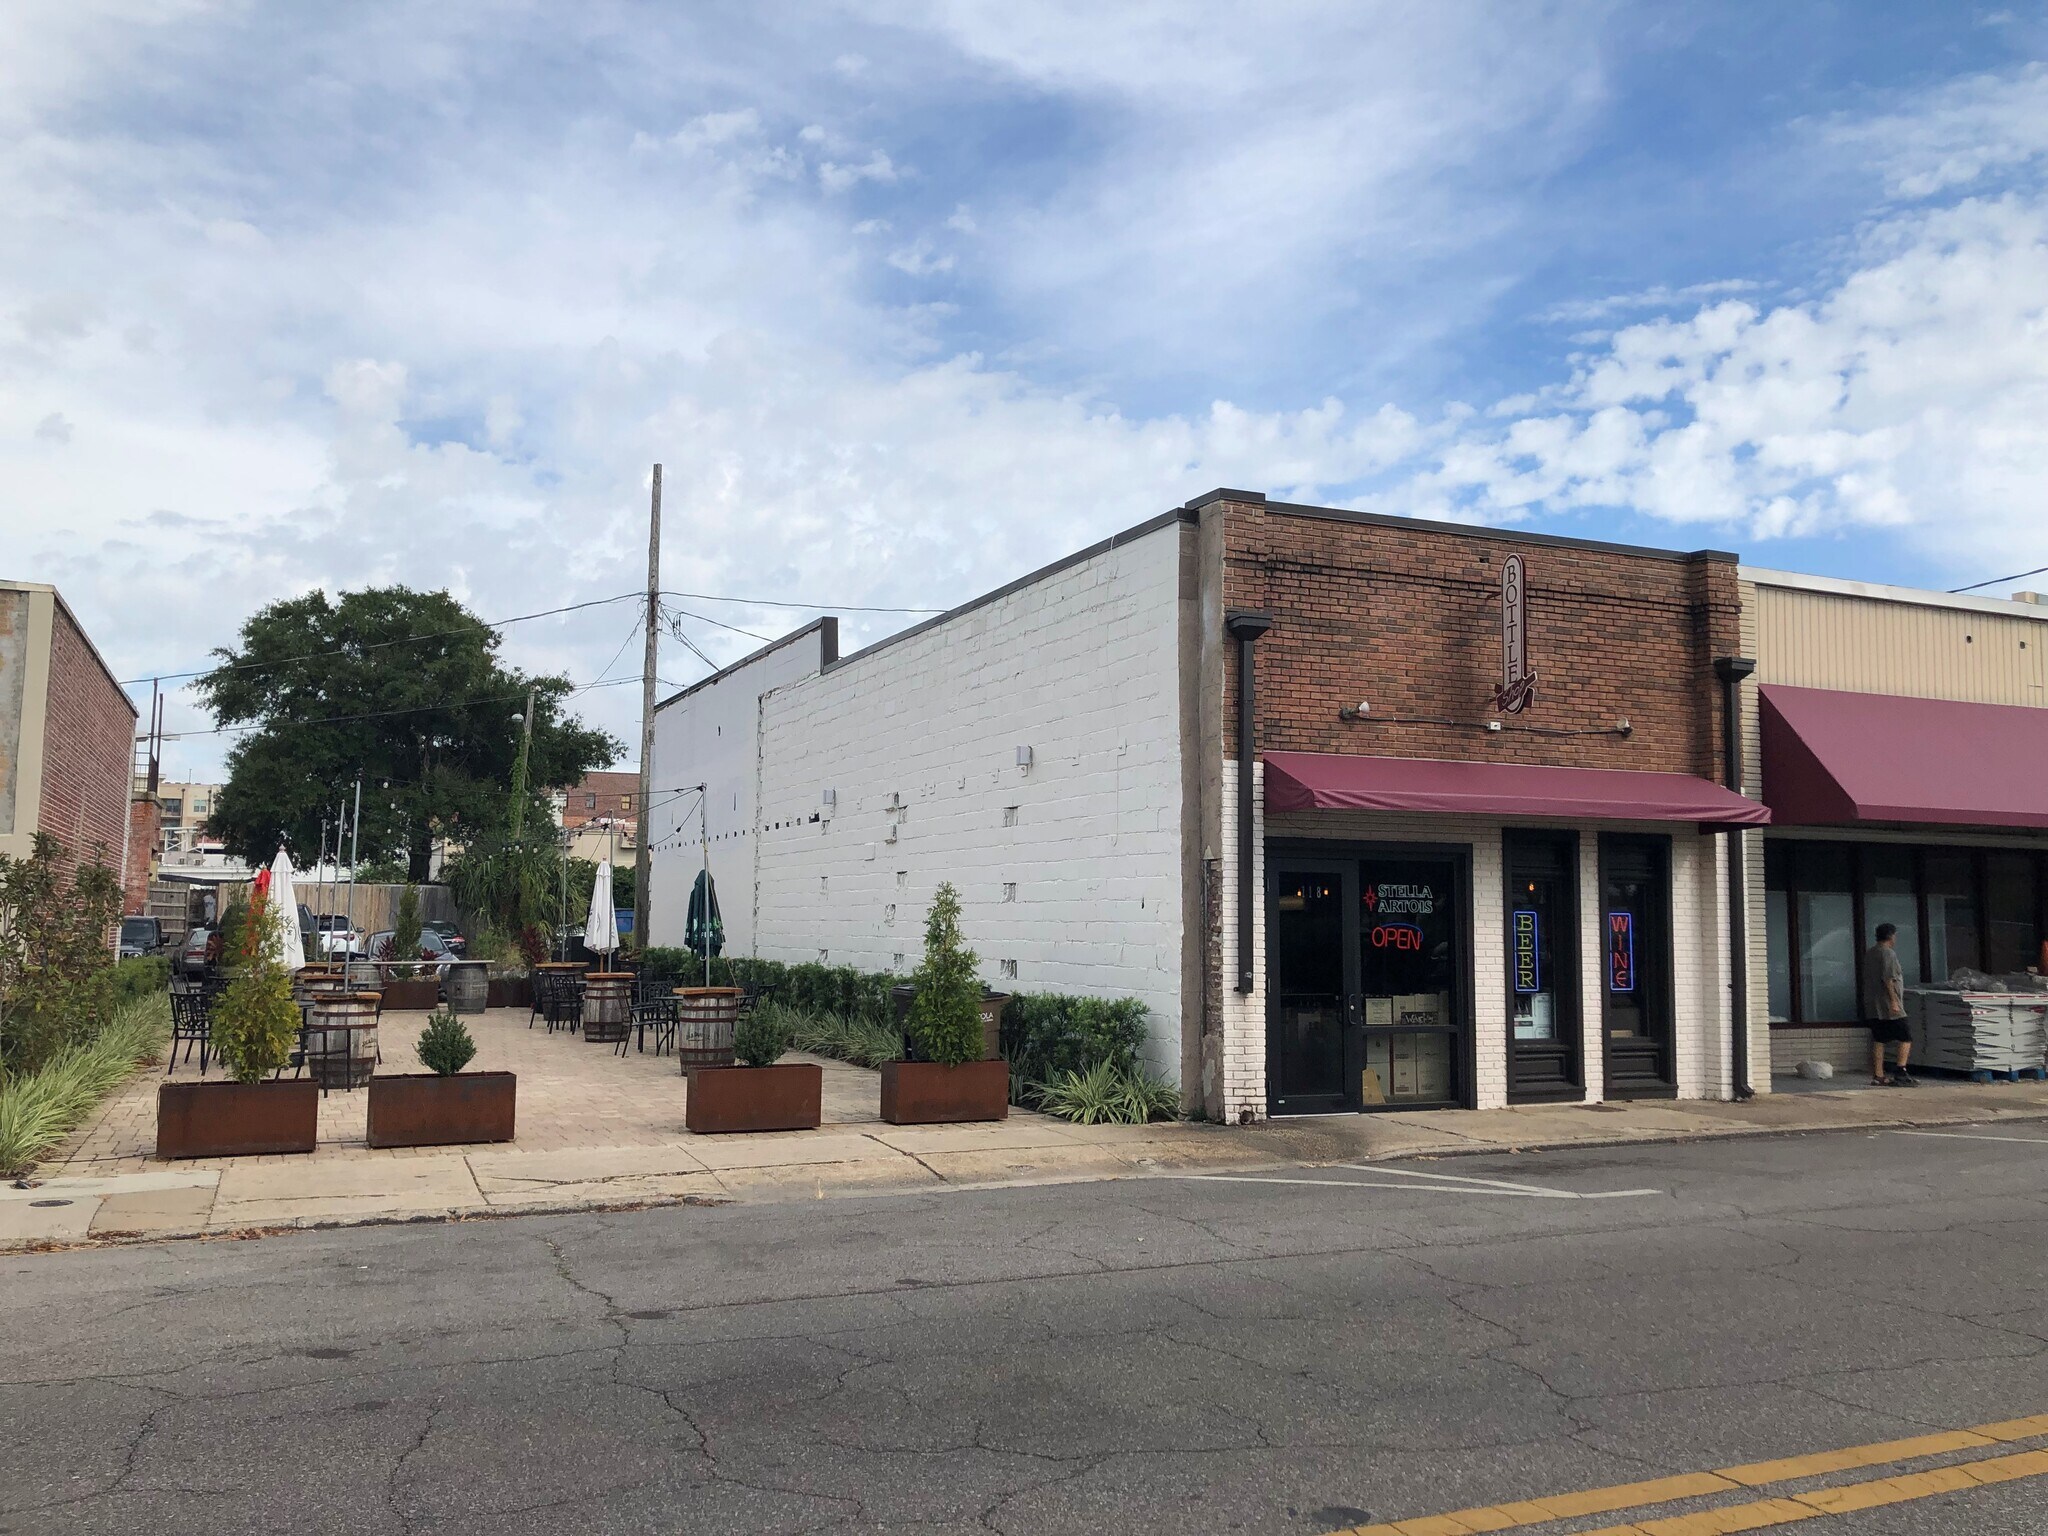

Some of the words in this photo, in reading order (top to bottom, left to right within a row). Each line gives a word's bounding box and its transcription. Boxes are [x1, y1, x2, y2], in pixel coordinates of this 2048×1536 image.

[1506, 564, 1518, 684] BOTTLE
[1302, 886, 1321, 898] 118
[1378, 884, 1433, 898] STELLA
[1378, 900, 1433, 913] ARTOIS
[1372, 927, 1421, 950] OPEN
[1517, 914, 1534, 988] BEER
[1611, 916, 1628, 987] WINE
